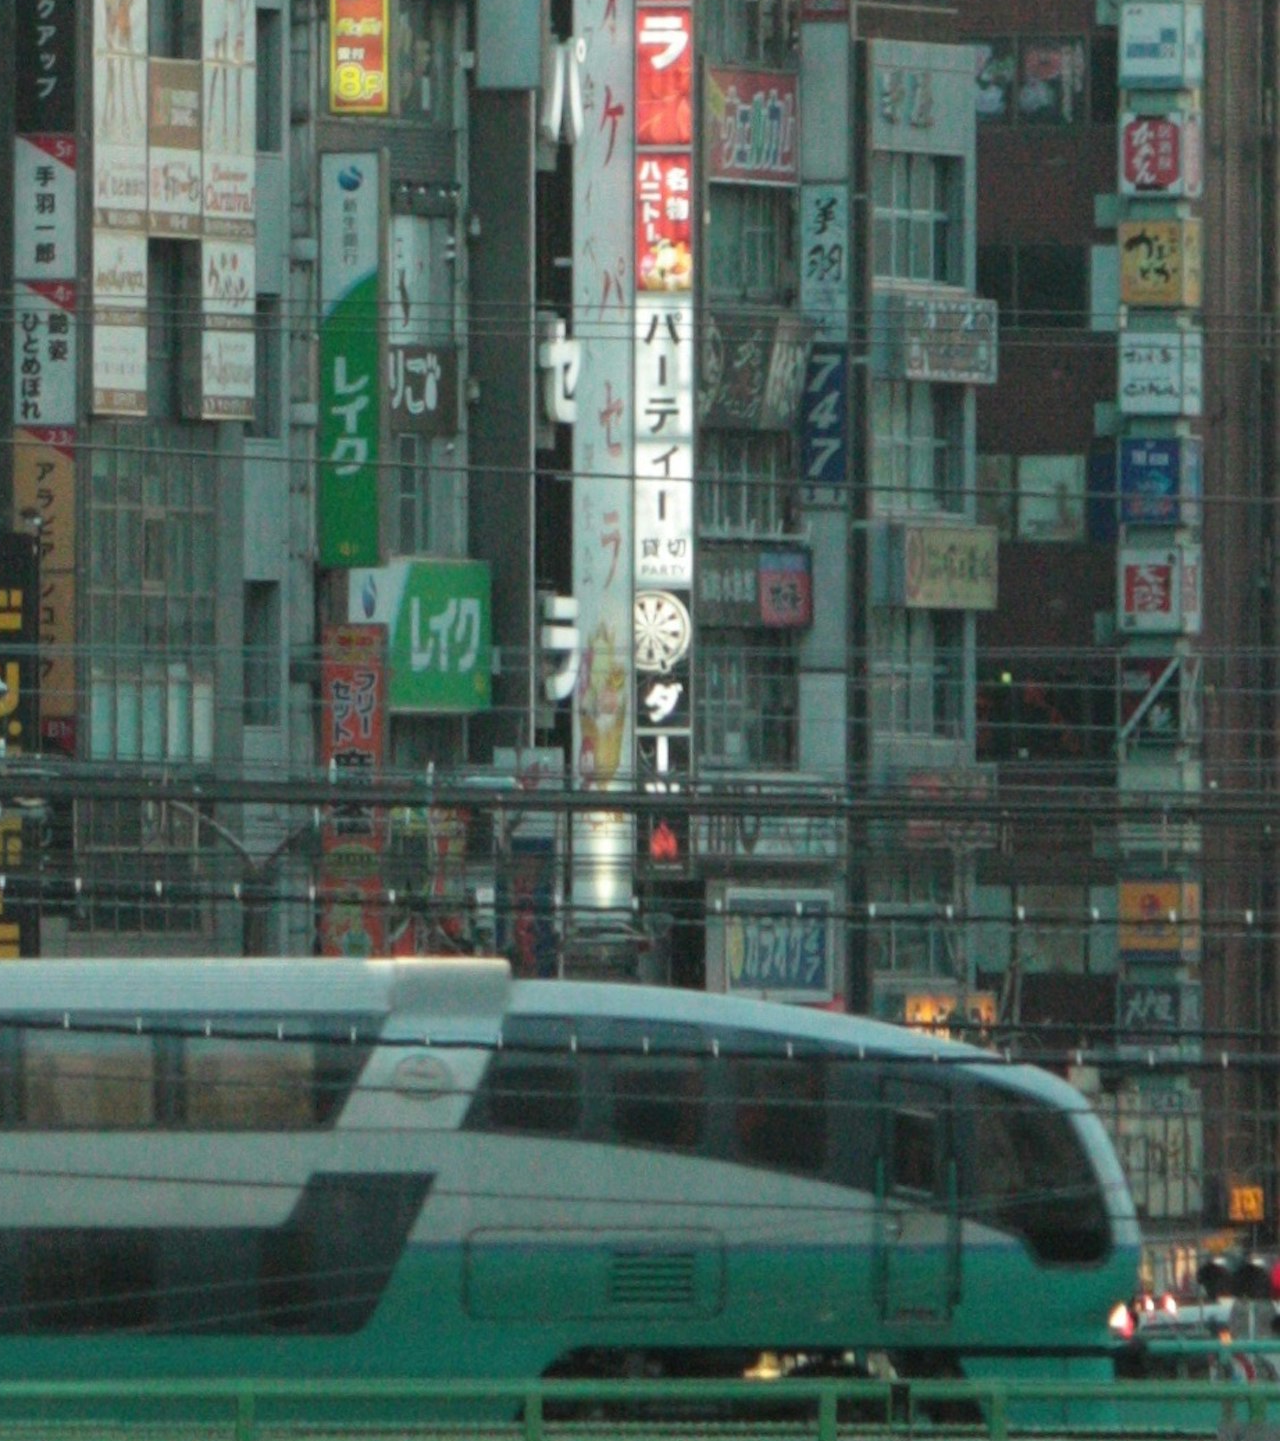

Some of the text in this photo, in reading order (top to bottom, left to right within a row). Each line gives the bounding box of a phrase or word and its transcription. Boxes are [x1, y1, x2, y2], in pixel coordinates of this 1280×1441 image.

[334, 62, 386, 102] 8F
[333, 356, 368, 476] レイク
[643, 310, 683, 522] パーティー
[640, 537, 688, 559] 貸切
[409, 596, 480, 673] レイク
